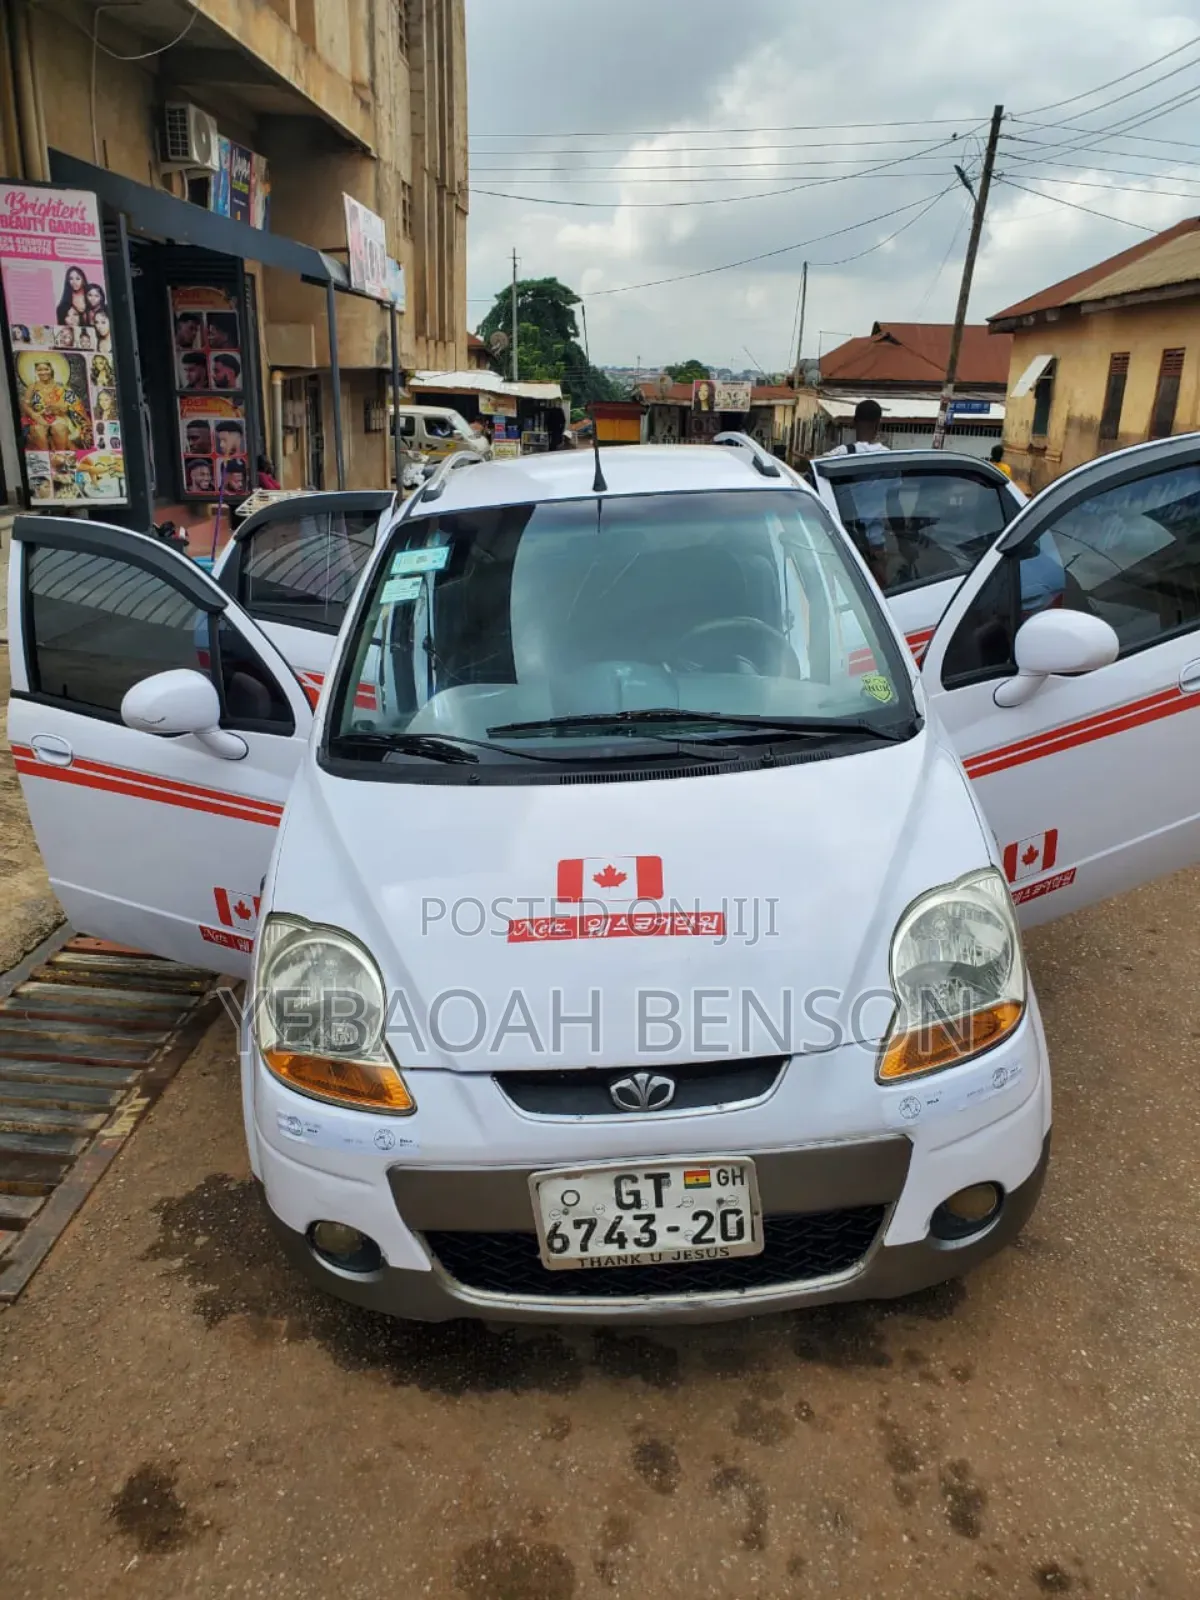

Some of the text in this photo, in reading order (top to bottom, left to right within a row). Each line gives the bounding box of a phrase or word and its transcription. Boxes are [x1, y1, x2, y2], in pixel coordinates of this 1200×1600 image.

[48, 219, 95, 236] GARDEN
[613, 1166, 746, 1211] GT GH
[546, 1208, 745, 1255] 6743-20
[579, 1246, 731, 1269] THANK U JESUS
